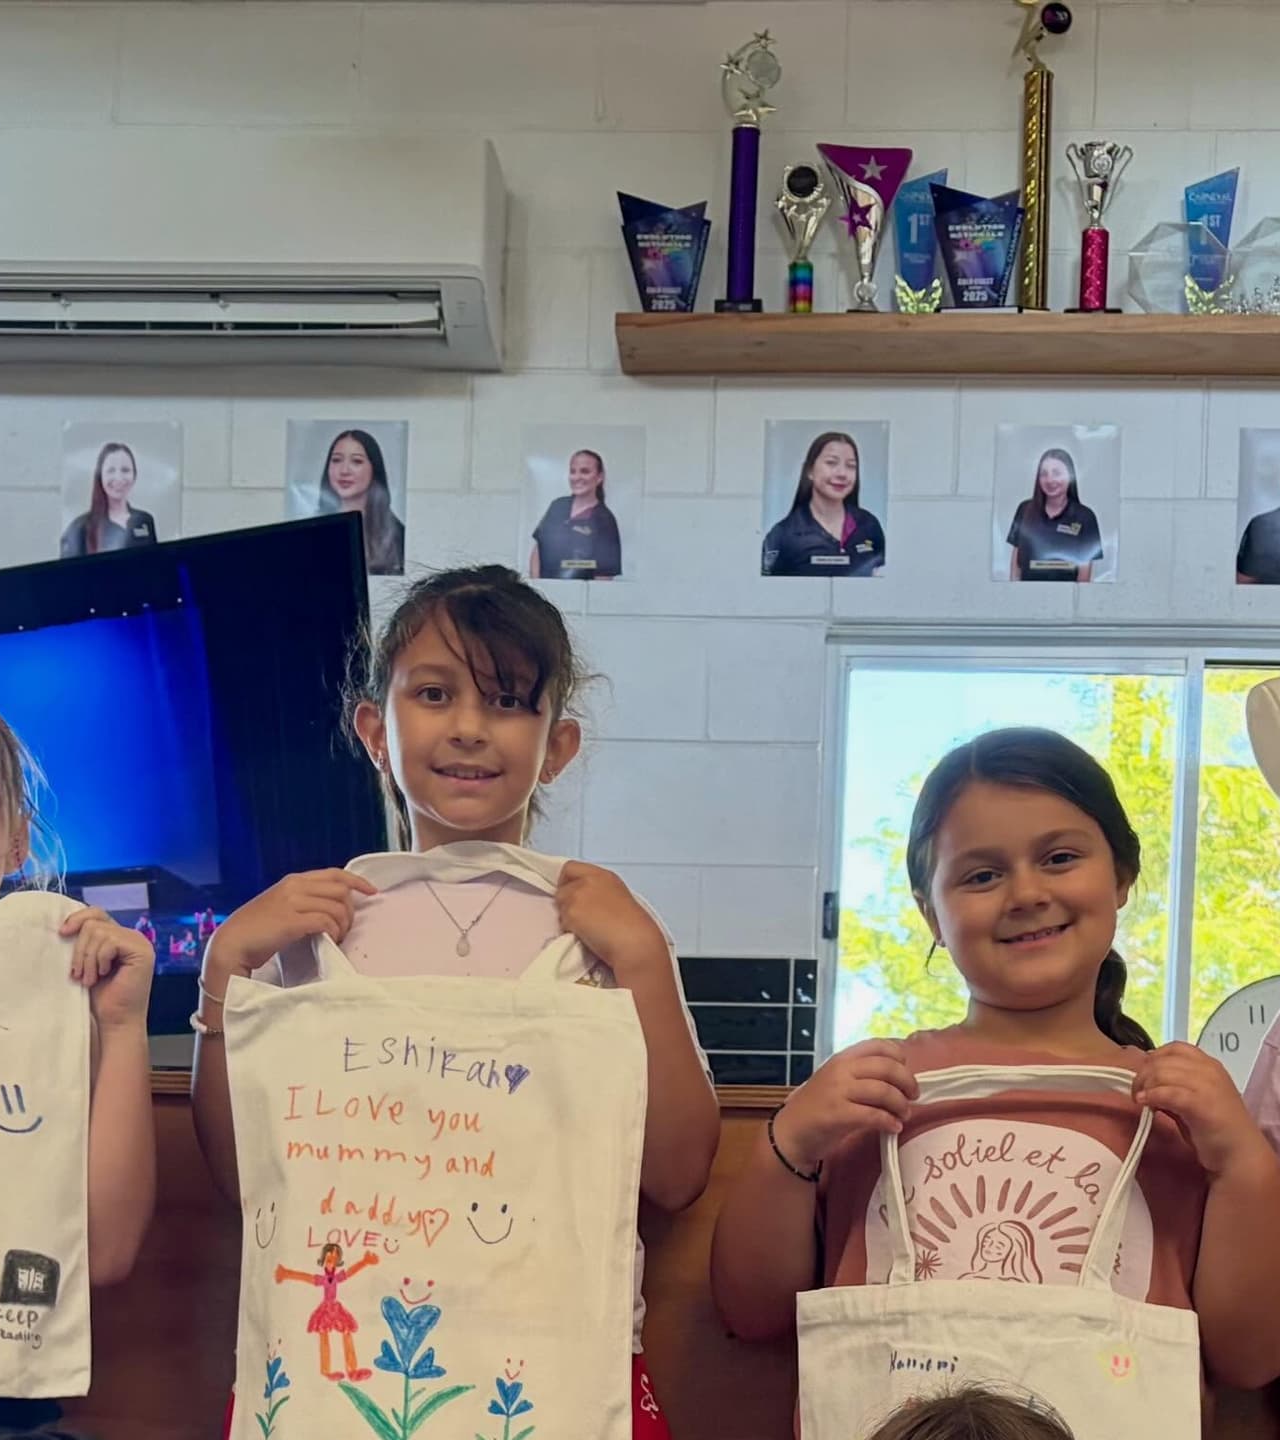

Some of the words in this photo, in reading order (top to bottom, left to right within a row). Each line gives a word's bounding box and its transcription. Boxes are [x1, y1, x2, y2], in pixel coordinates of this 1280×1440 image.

[1249, 1004, 1266, 1025] 11
[1219, 1031, 1240, 1054] 10
[283, 1085, 305, 1121] I
[428, 1108, 482, 1141] you
[287, 1140, 432, 1181] mummy
[446, 1150, 496, 1178] and
[923, 1131, 1016, 1185] soliel
[1023, 1145, 1067, 1174] et
[1064, 1162, 1101, 1205] la
[320, 1186, 422, 1235] daddy
[307, 1225, 381, 1248] LOVE
